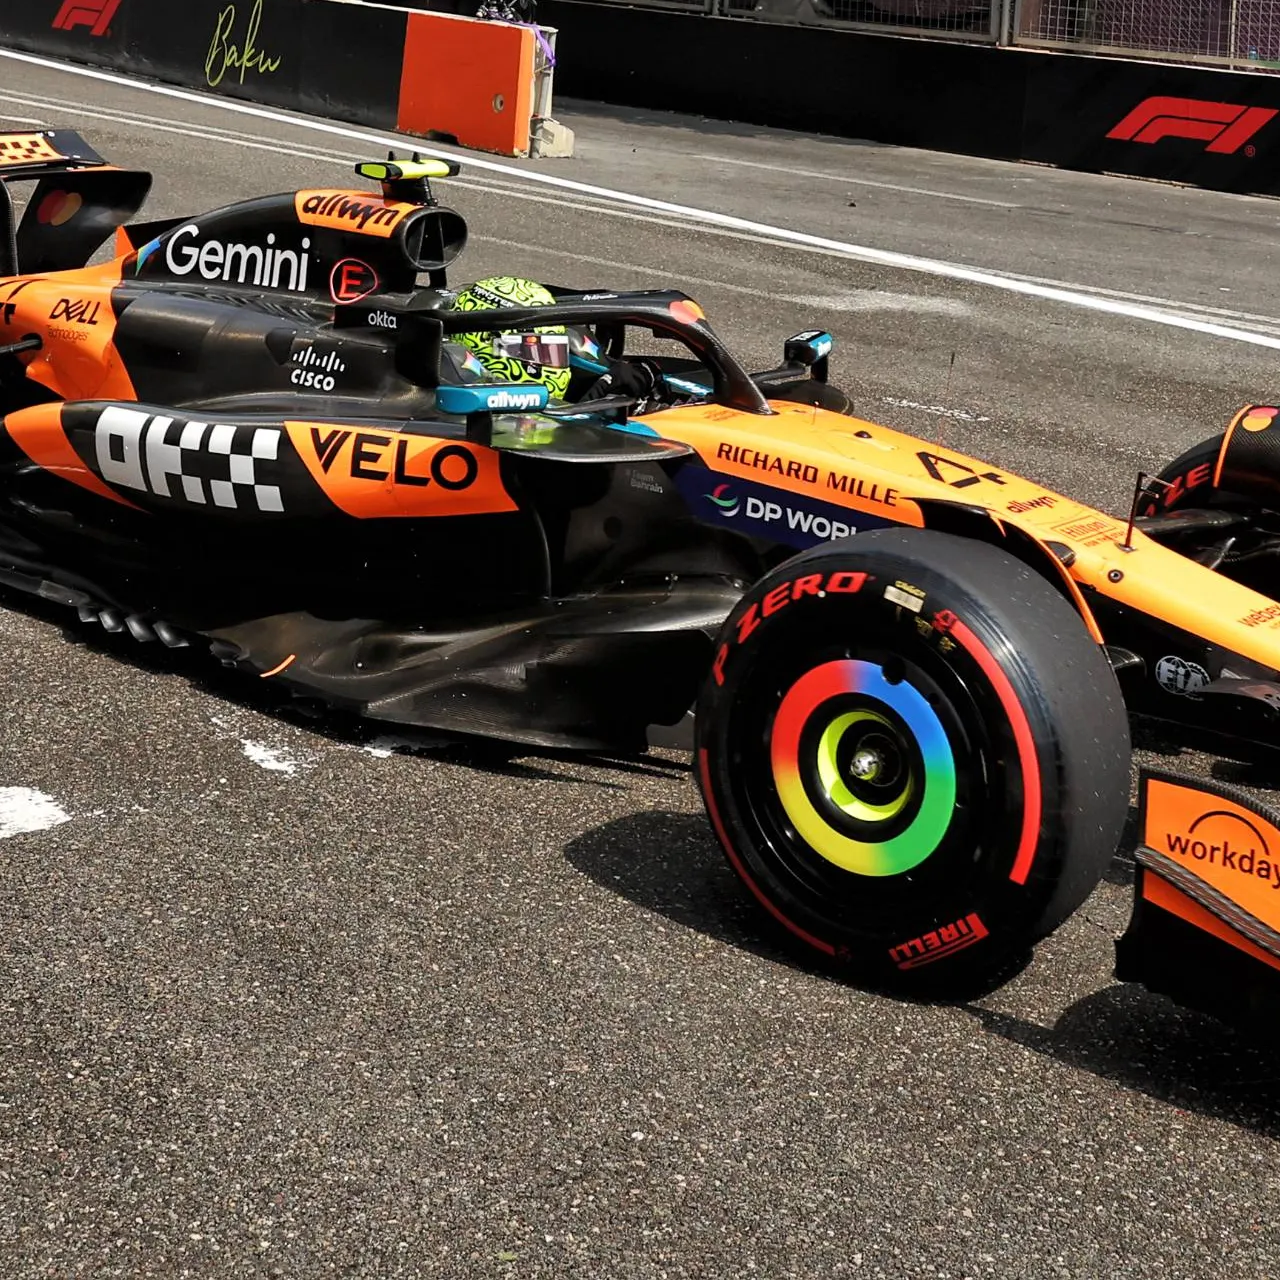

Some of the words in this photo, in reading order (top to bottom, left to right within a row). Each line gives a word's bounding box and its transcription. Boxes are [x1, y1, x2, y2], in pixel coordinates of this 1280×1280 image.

[302, 193, 400, 230] allwyn
[166, 224, 310, 292] Gemini
[49, 298, 101, 326] DELL
[367, 310, 398, 329] okta
[487, 390, 541, 411] allwyn
[310, 428, 479, 491] VELO
[717, 442, 819, 484] RICHARD
[826, 471, 900, 507] MILLE
[1163, 463, 1210, 507] ZE
[745, 496, 783, 522] DP
[1007, 496, 1058, 514] allwyn
[1061, 520, 1108, 538] Hilton
[736, 571, 869, 645] ZERO
[888, 912, 990, 971] PIRELLI
